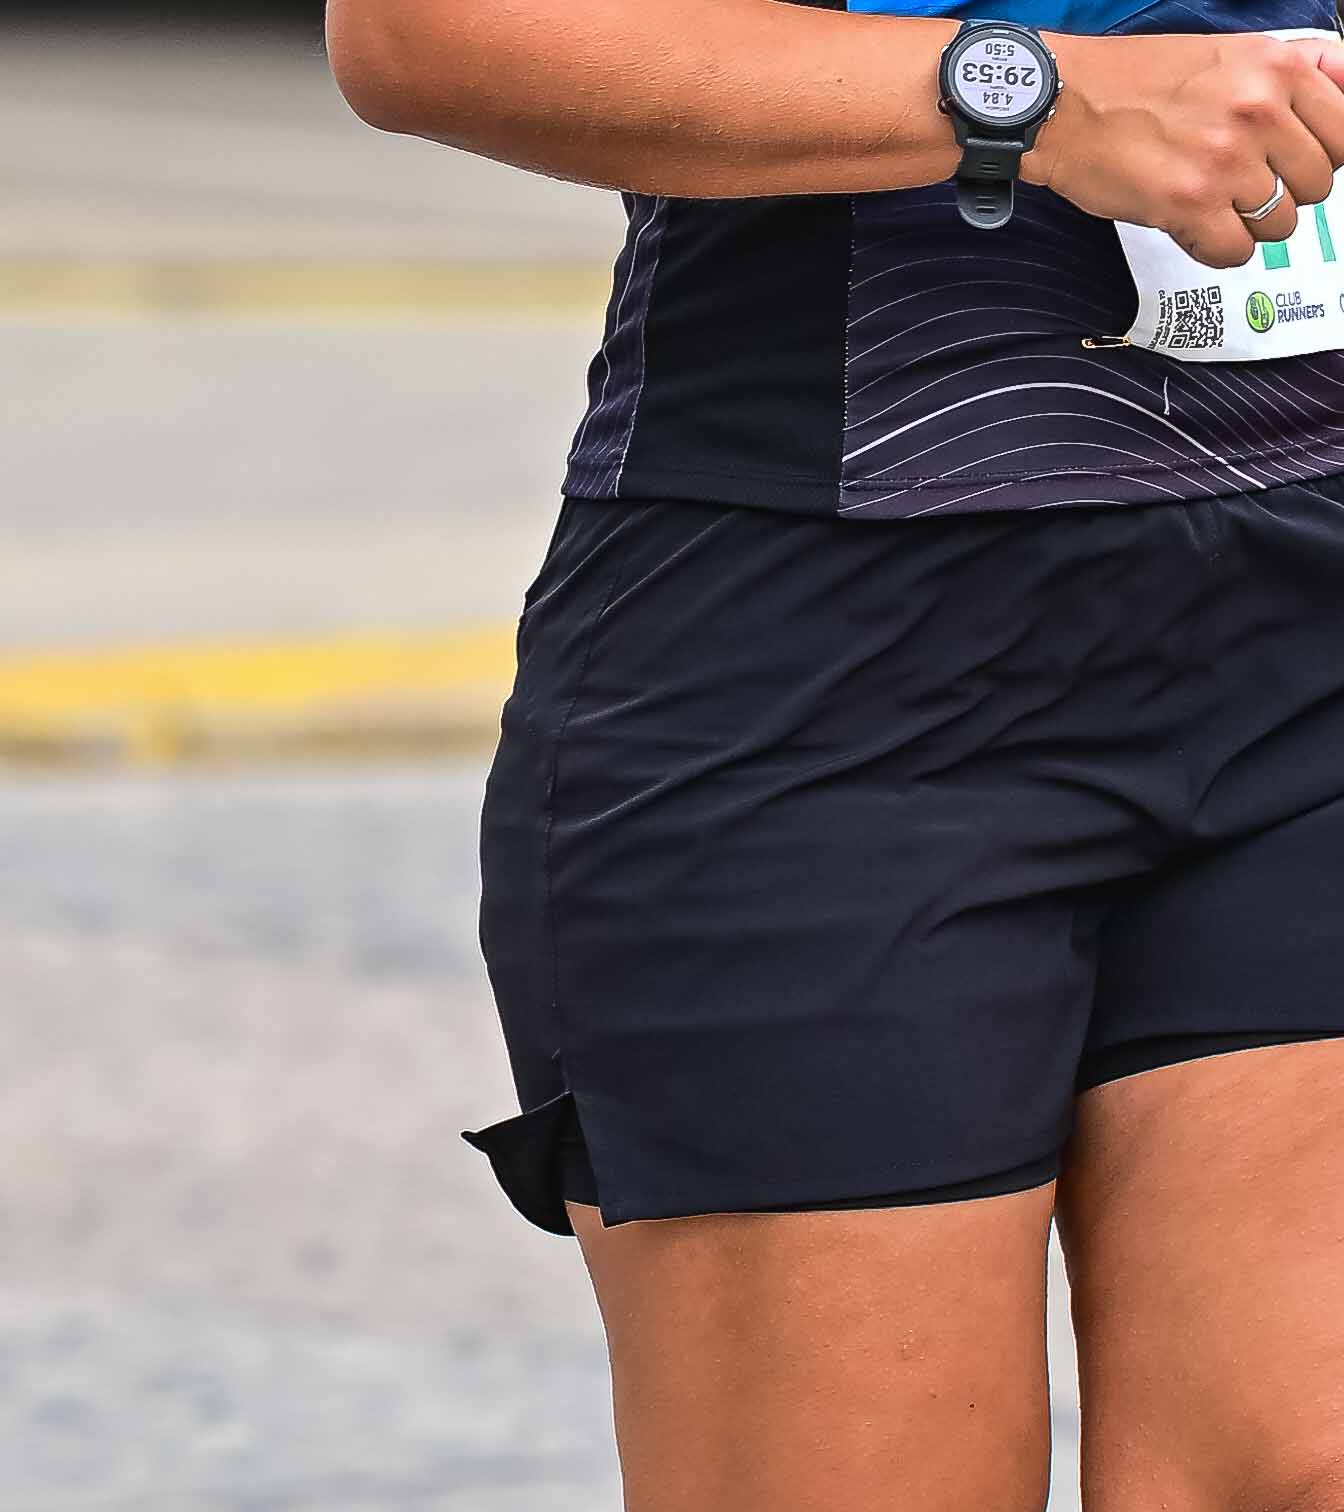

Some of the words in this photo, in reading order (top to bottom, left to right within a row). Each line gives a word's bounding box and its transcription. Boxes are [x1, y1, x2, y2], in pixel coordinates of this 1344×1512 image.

[985, 42, 1015, 57] 5:50
[962, 62, 1036, 87] 29:53
[984, 92, 1013, 106] 4.84
[1275, 290, 1302, 307] CLUB
